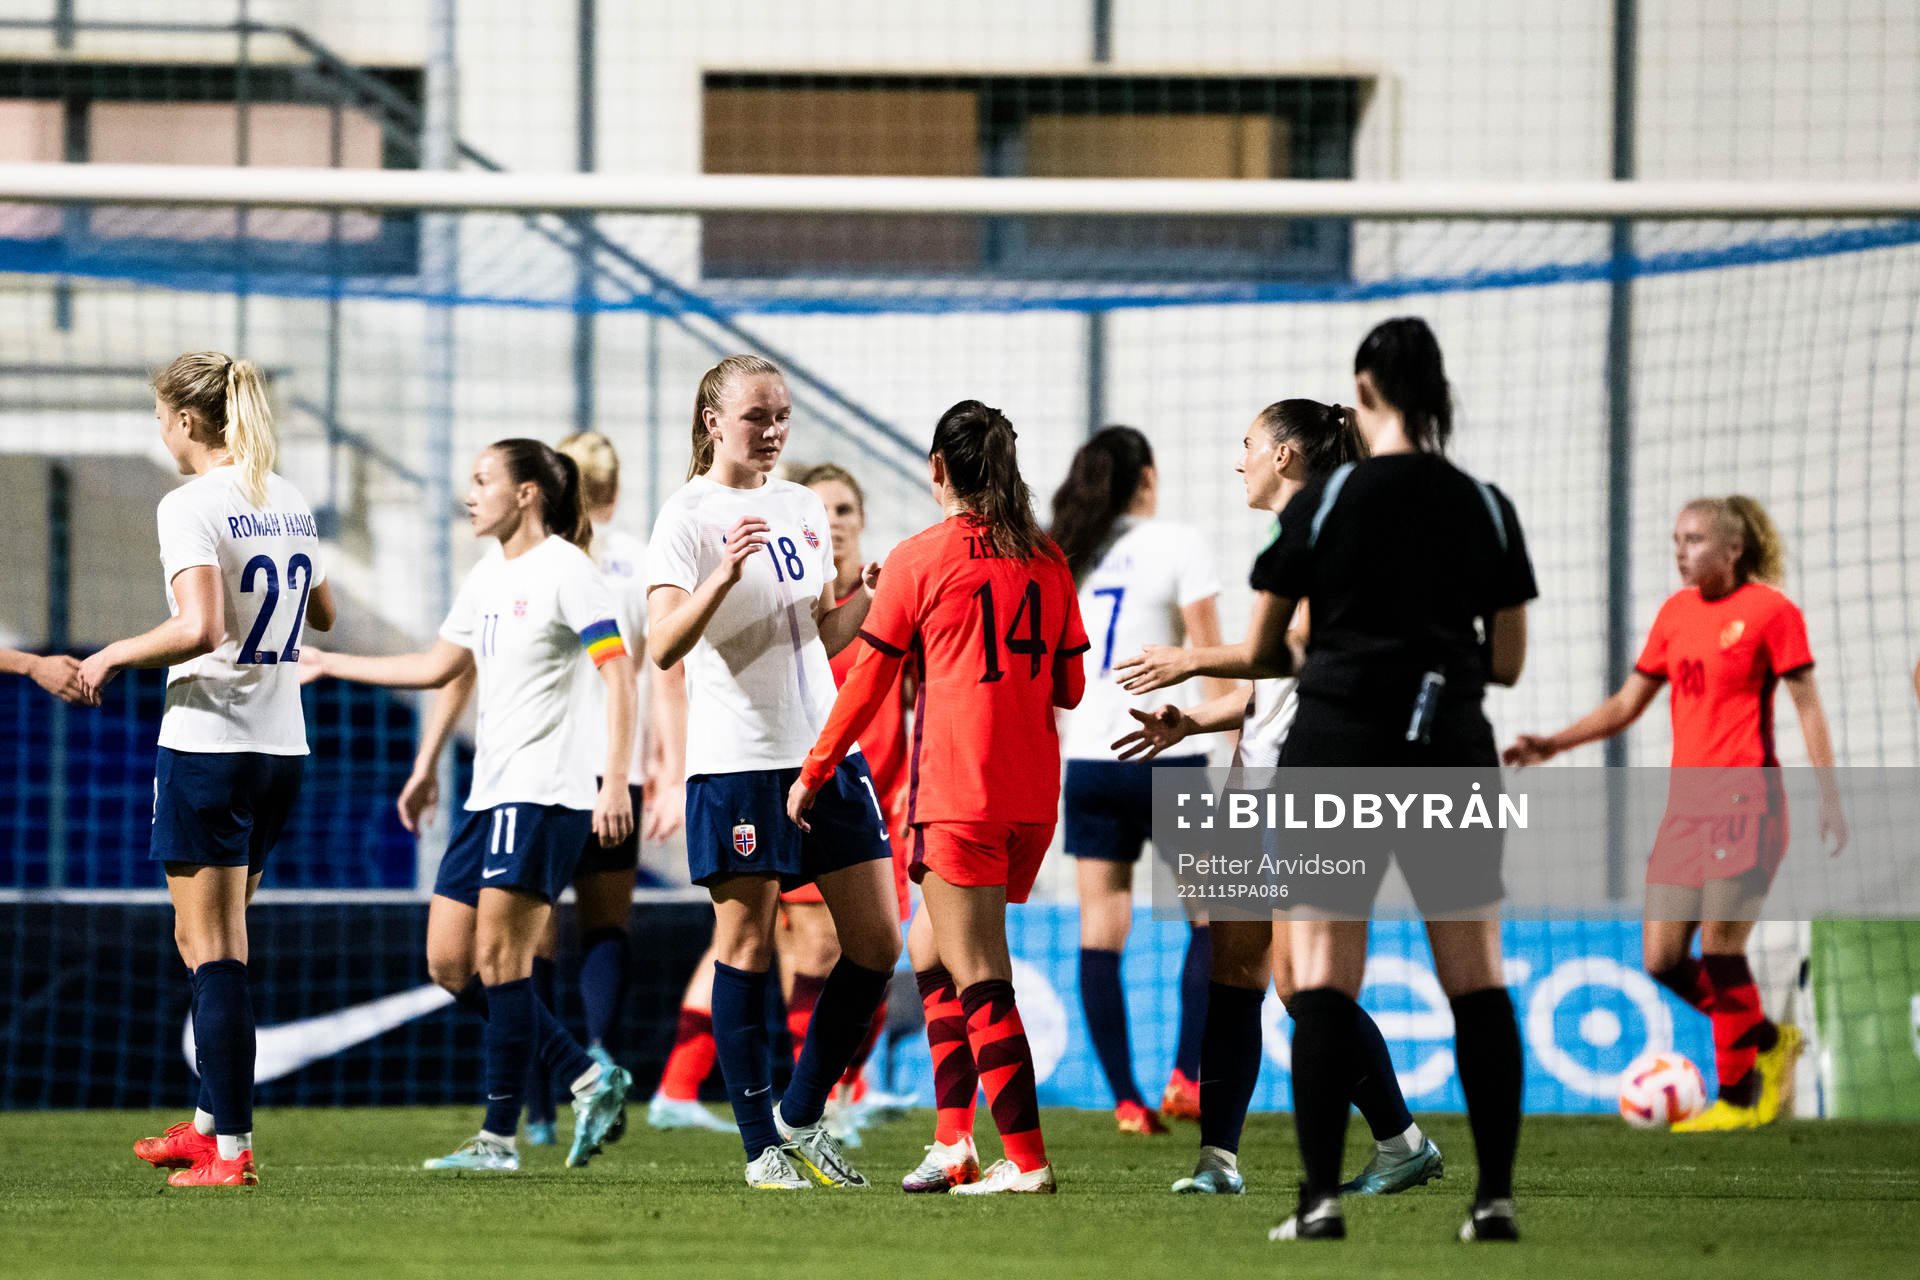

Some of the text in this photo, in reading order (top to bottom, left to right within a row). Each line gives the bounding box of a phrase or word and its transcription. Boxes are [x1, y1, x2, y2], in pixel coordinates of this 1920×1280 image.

[228, 512, 281, 539] ROMAN
[765, 536, 805, 582] 18
[236, 553, 313, 665] 22
[972, 579, 1048, 683] 14
[1092, 586, 1126, 678] 7
[481, 613, 499, 657] 11
[490, 807, 518, 855] 11
